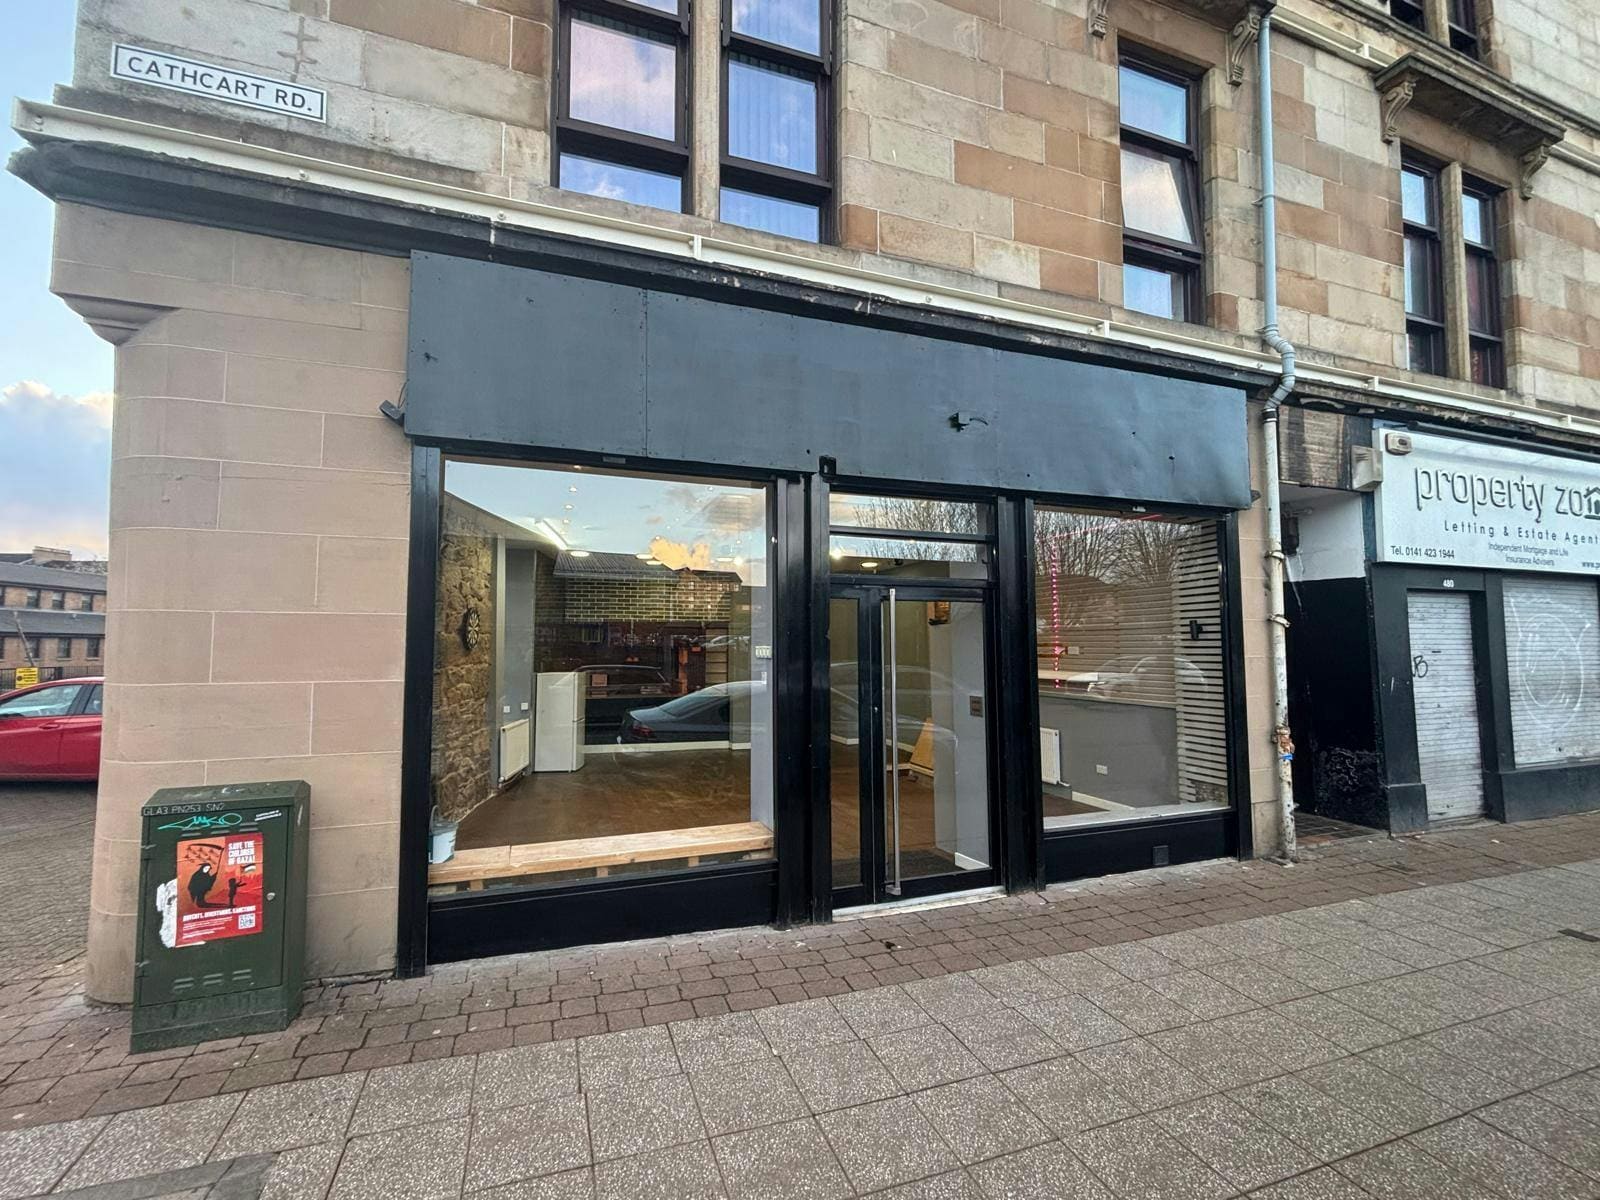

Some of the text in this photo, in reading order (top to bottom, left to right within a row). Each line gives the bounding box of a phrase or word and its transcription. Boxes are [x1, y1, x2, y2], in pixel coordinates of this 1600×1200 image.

[128, 57, 312, 111] CATHCART RD.
[1415, 467, 1545, 523] property
[1444, 520, 1495, 538] Letting
[1503, 526, 1509, 537] &
[1518, 527, 1557, 541] Estate
[1390, 545, 1455, 559] Tel. 0141 423 1944
[1488, 542, 1521, 554] Independent
[1523, 544, 1549, 556] Mortgage
[1549, 548, 1559, 556] and
[1506, 556, 1532, 565] Insurance
[143, 806, 169, 817] GLA3
